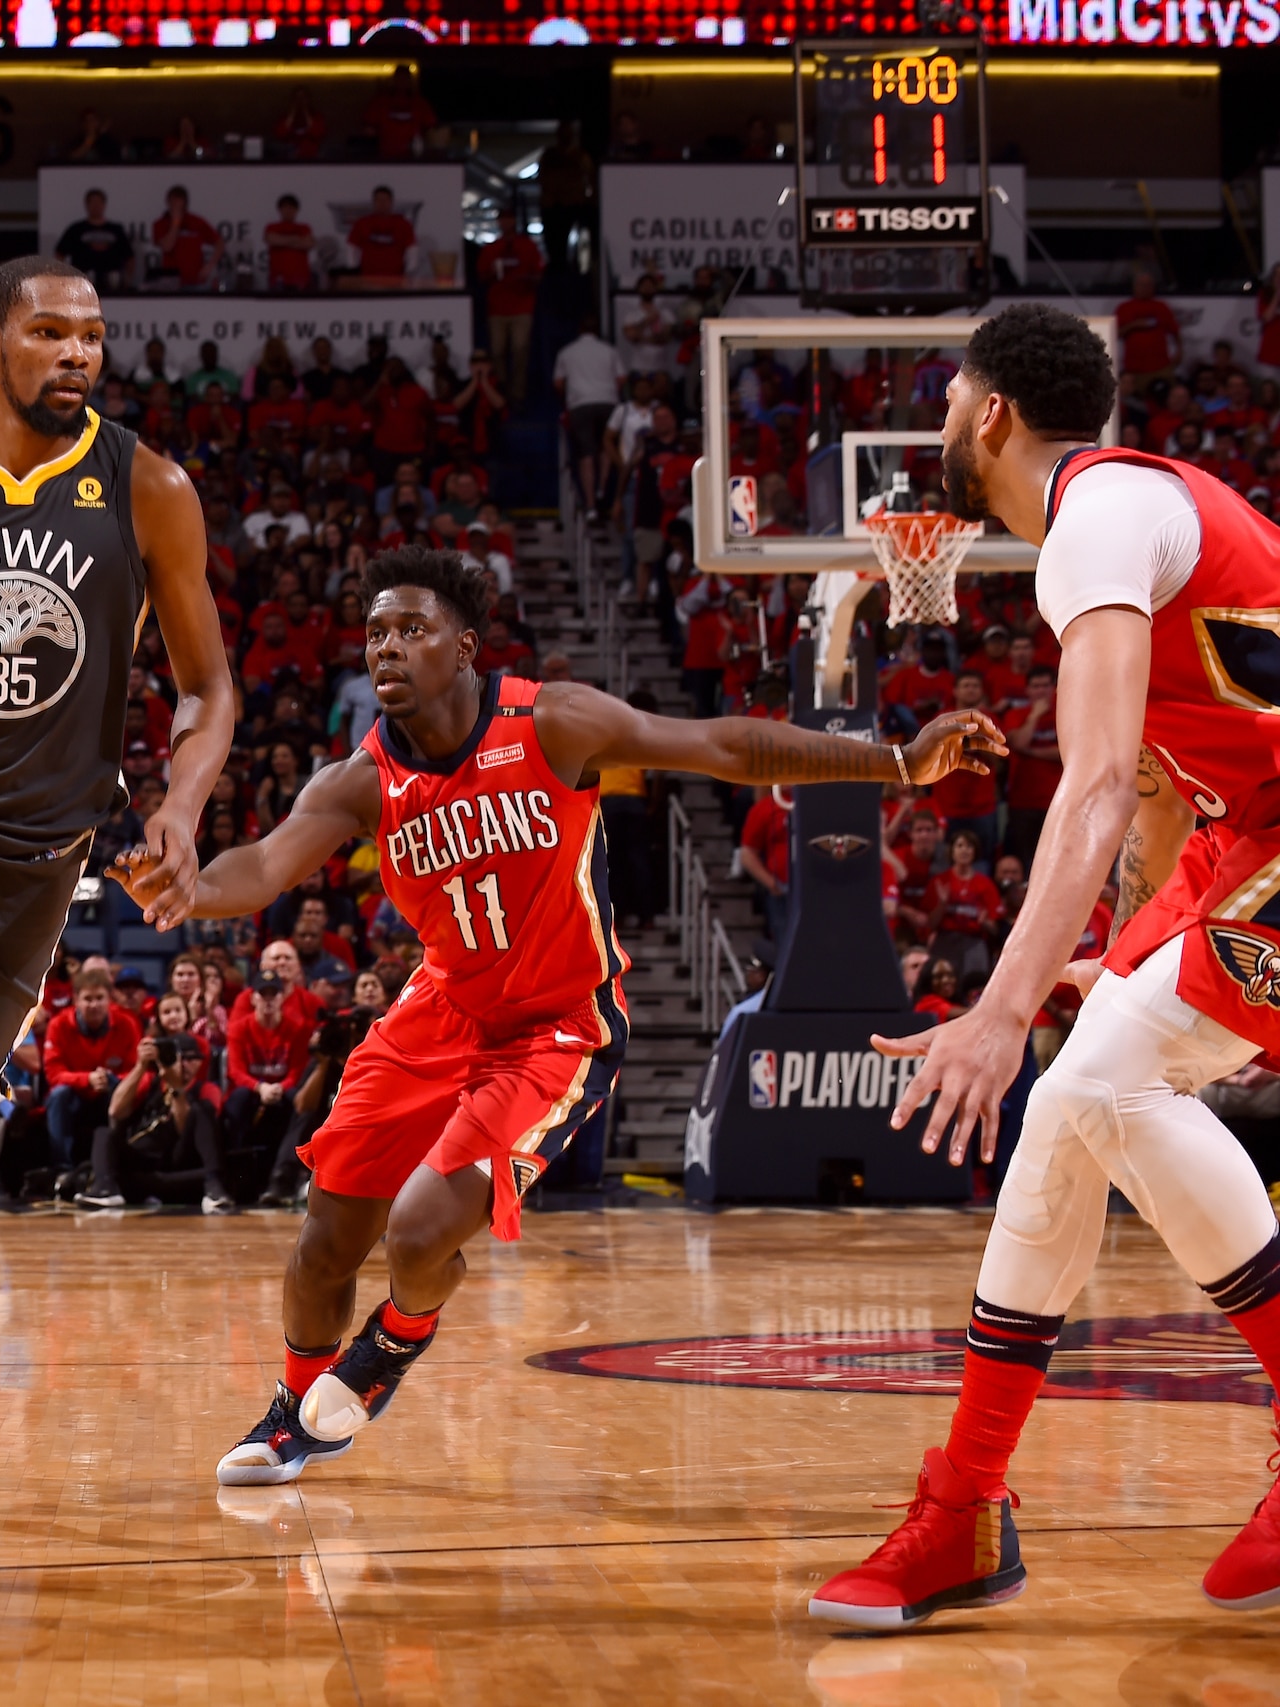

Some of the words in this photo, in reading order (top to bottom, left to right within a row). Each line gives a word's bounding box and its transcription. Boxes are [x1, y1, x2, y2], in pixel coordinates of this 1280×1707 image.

[872, 56, 958, 104] 1:00
[630, 218, 767, 241] CADILLAC
[857, 206, 976, 231] TISSOT
[218, 221, 249, 242] OF
[213, 322, 243, 340] OF
[258, 321, 316, 340] NEW
[323, 320, 453, 340] ORLEANS
[74, 499, 106, 508] Rakuten
[386, 790, 559, 877] PELICANS
[442, 873, 510, 951] 11
